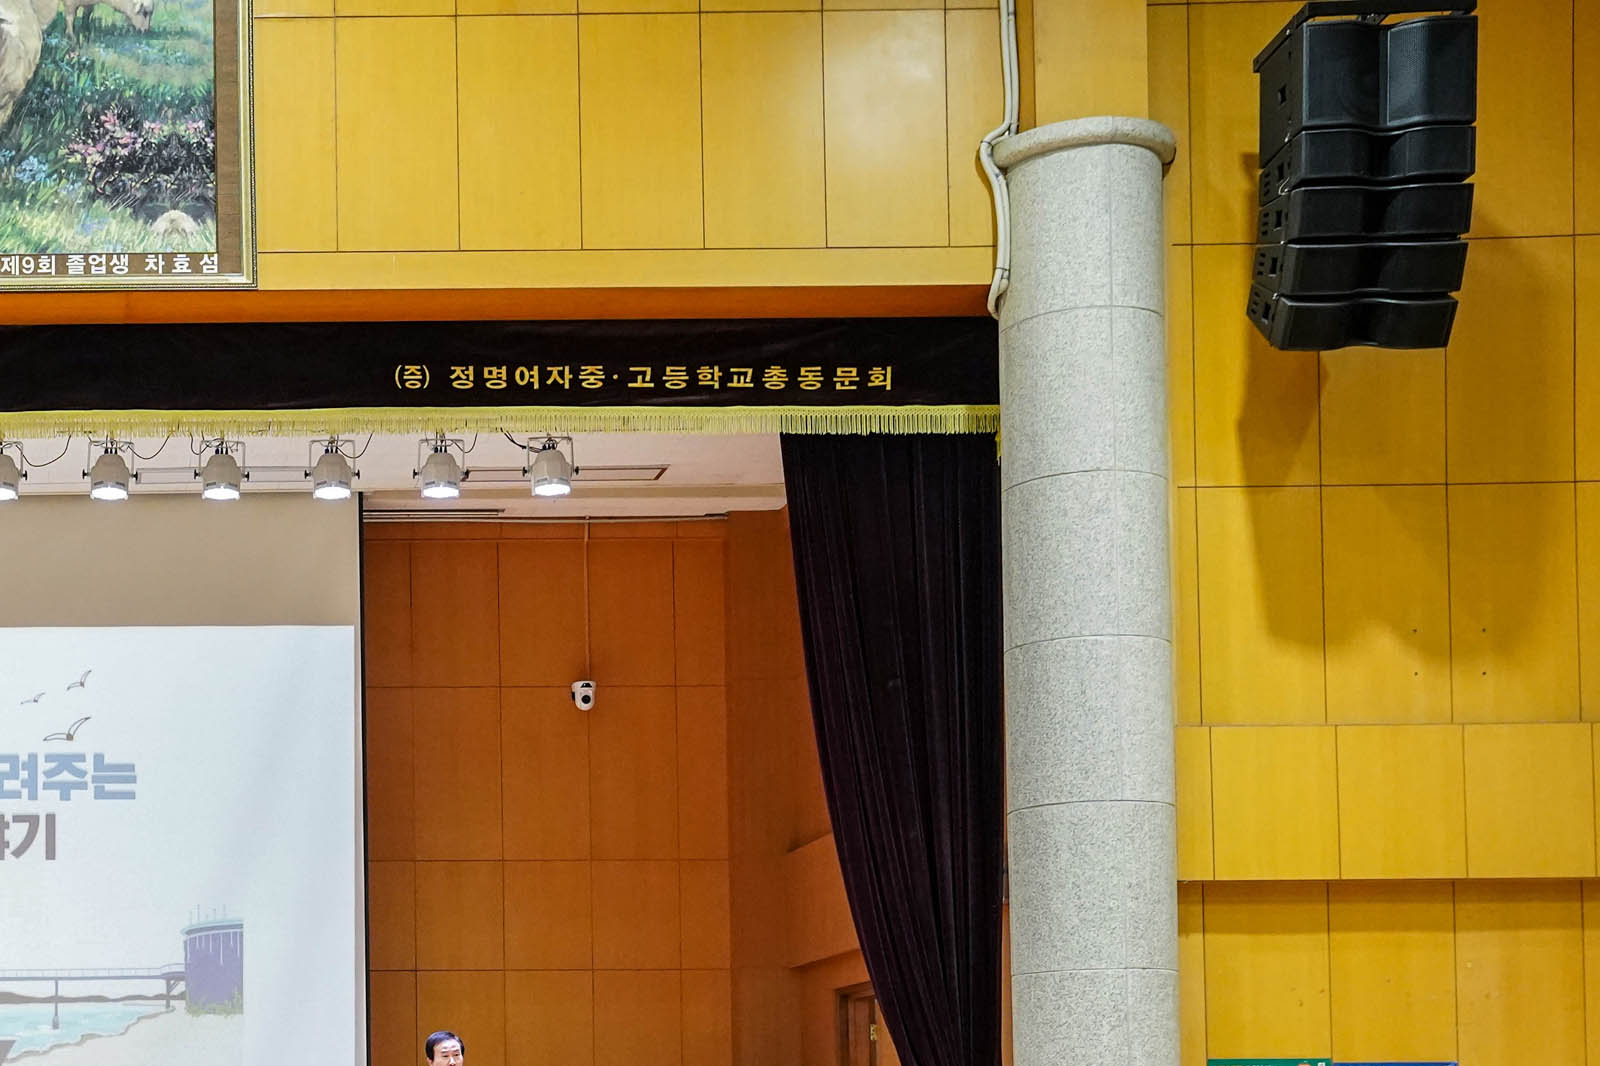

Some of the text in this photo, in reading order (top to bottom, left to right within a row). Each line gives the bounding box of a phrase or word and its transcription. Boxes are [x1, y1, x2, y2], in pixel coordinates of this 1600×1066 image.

[0, 254, 57, 276] 제9회
[66, 254, 129, 276] 졸업생
[394, 364, 894, 391] (증) 정명여자중·고등학교총동문회
